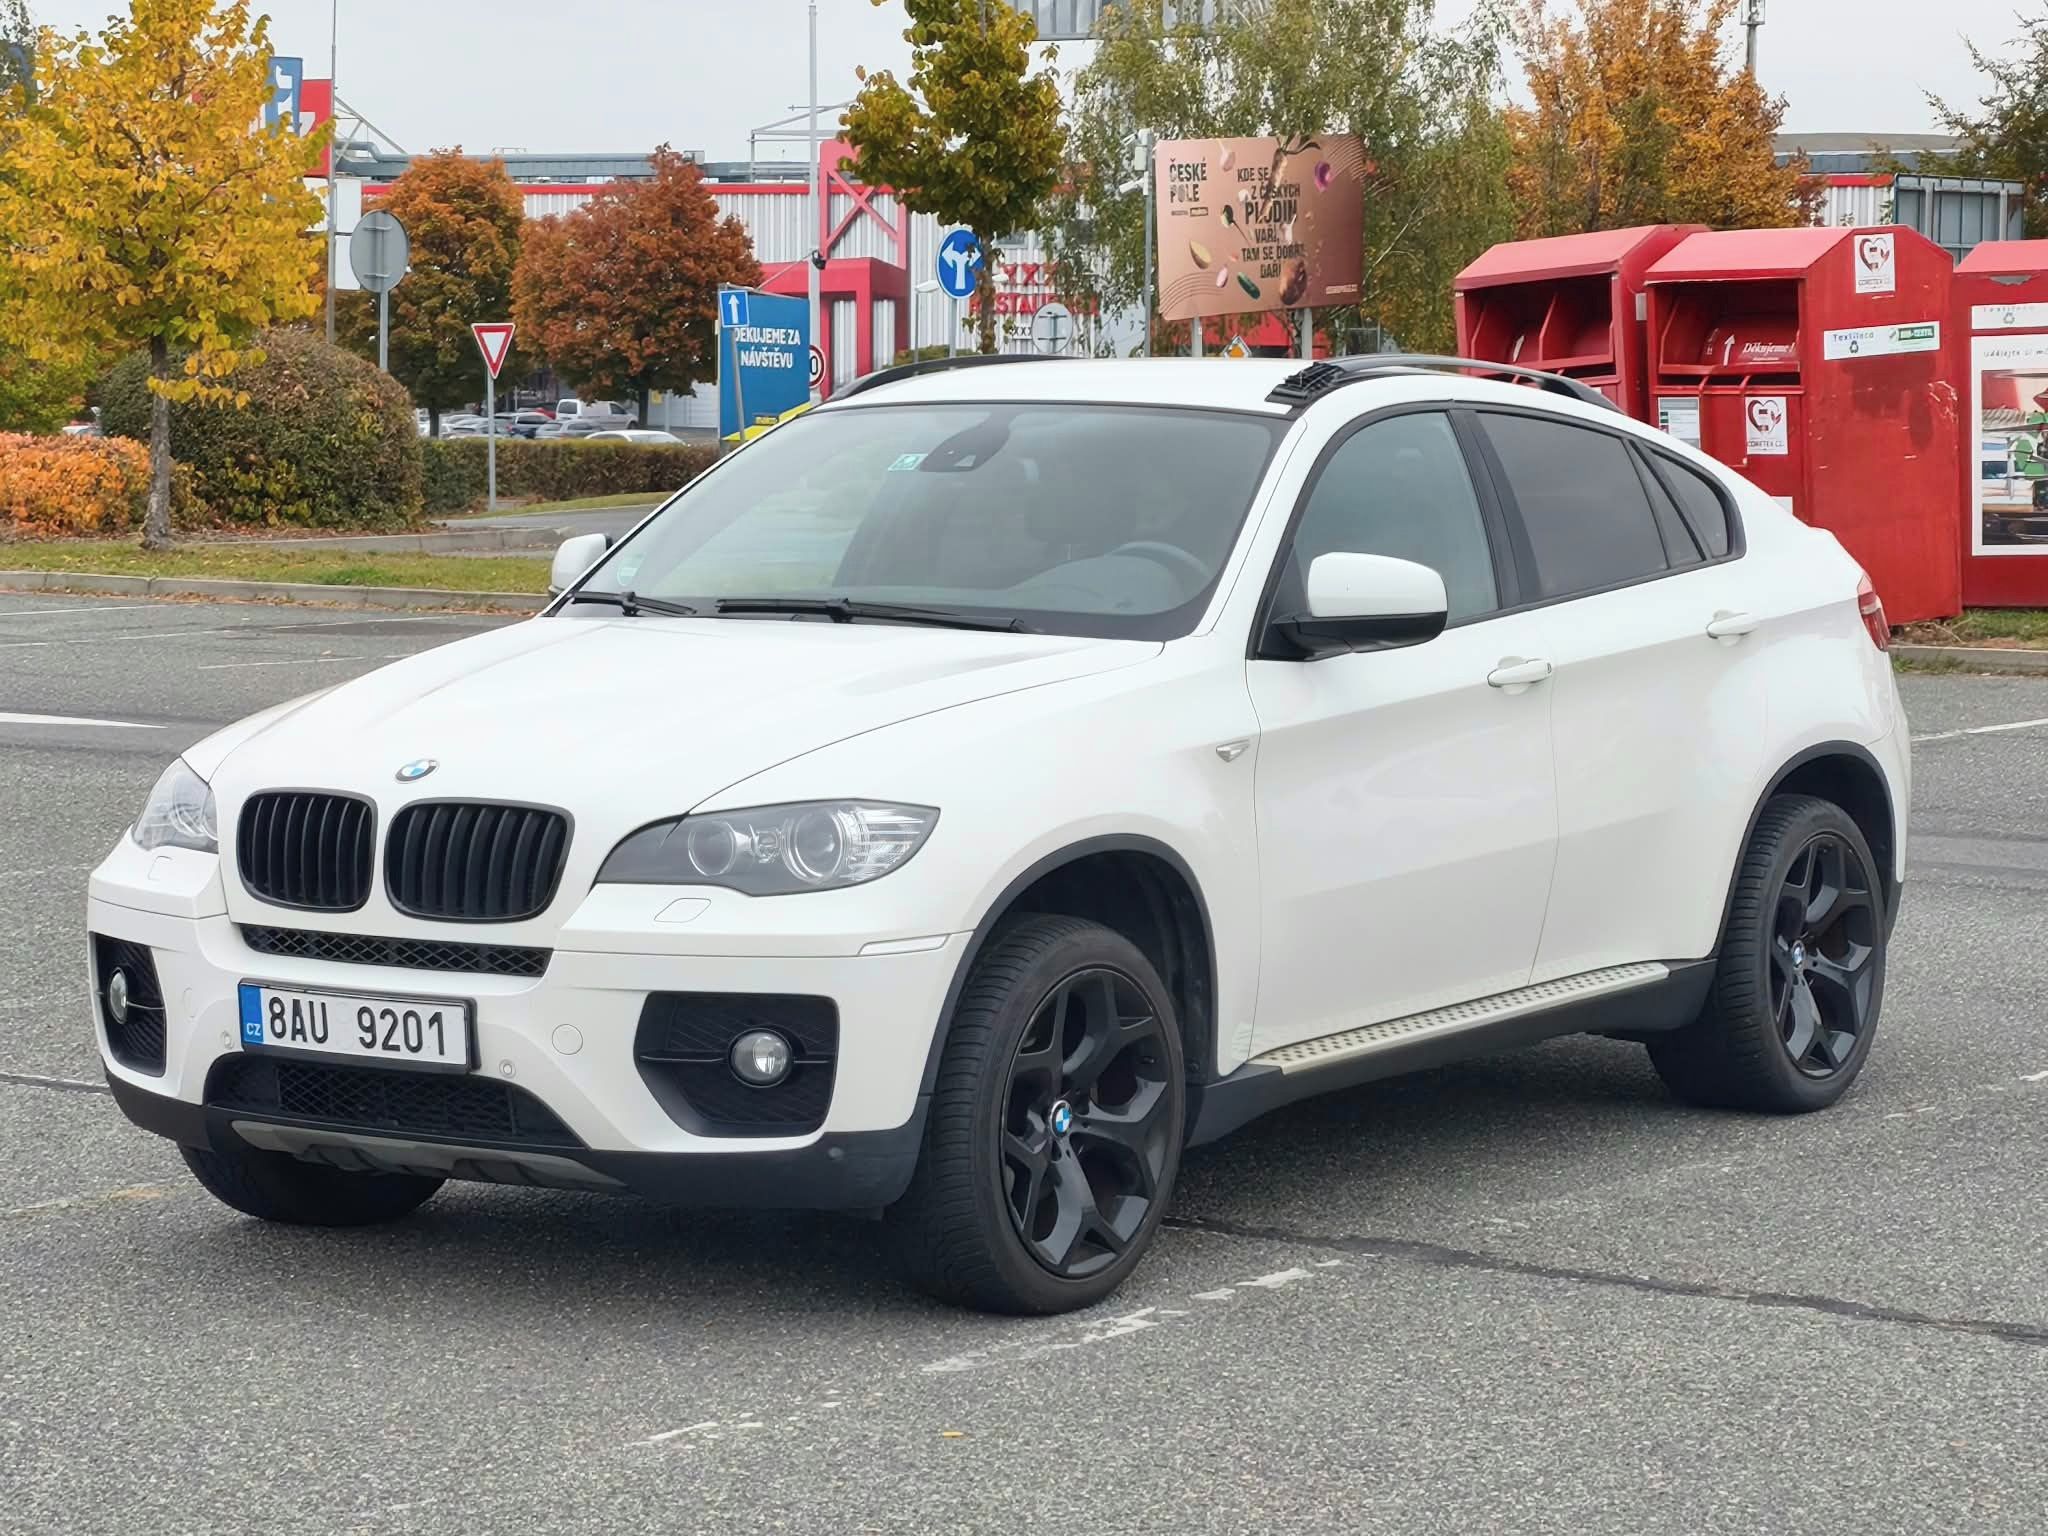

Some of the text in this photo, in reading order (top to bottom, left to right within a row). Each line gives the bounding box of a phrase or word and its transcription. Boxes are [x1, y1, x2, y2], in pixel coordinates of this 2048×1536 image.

[1170, 157, 1207, 183] ČESKÉ
[1237, 167, 1270, 182] KDE SE
[1170, 184, 1200, 202] POLE
[1241, 246, 1260, 262] TAM
[1262, 245, 1274, 261] SE
[788, 329, 801, 345] ZA
[741, 345, 793, 368] NÁVŠTĚVU
[810, 355, 818, 375] 0
[246, 1022, 262, 1037] CZ
[268, 996, 445, 1056] 8AU 9201
